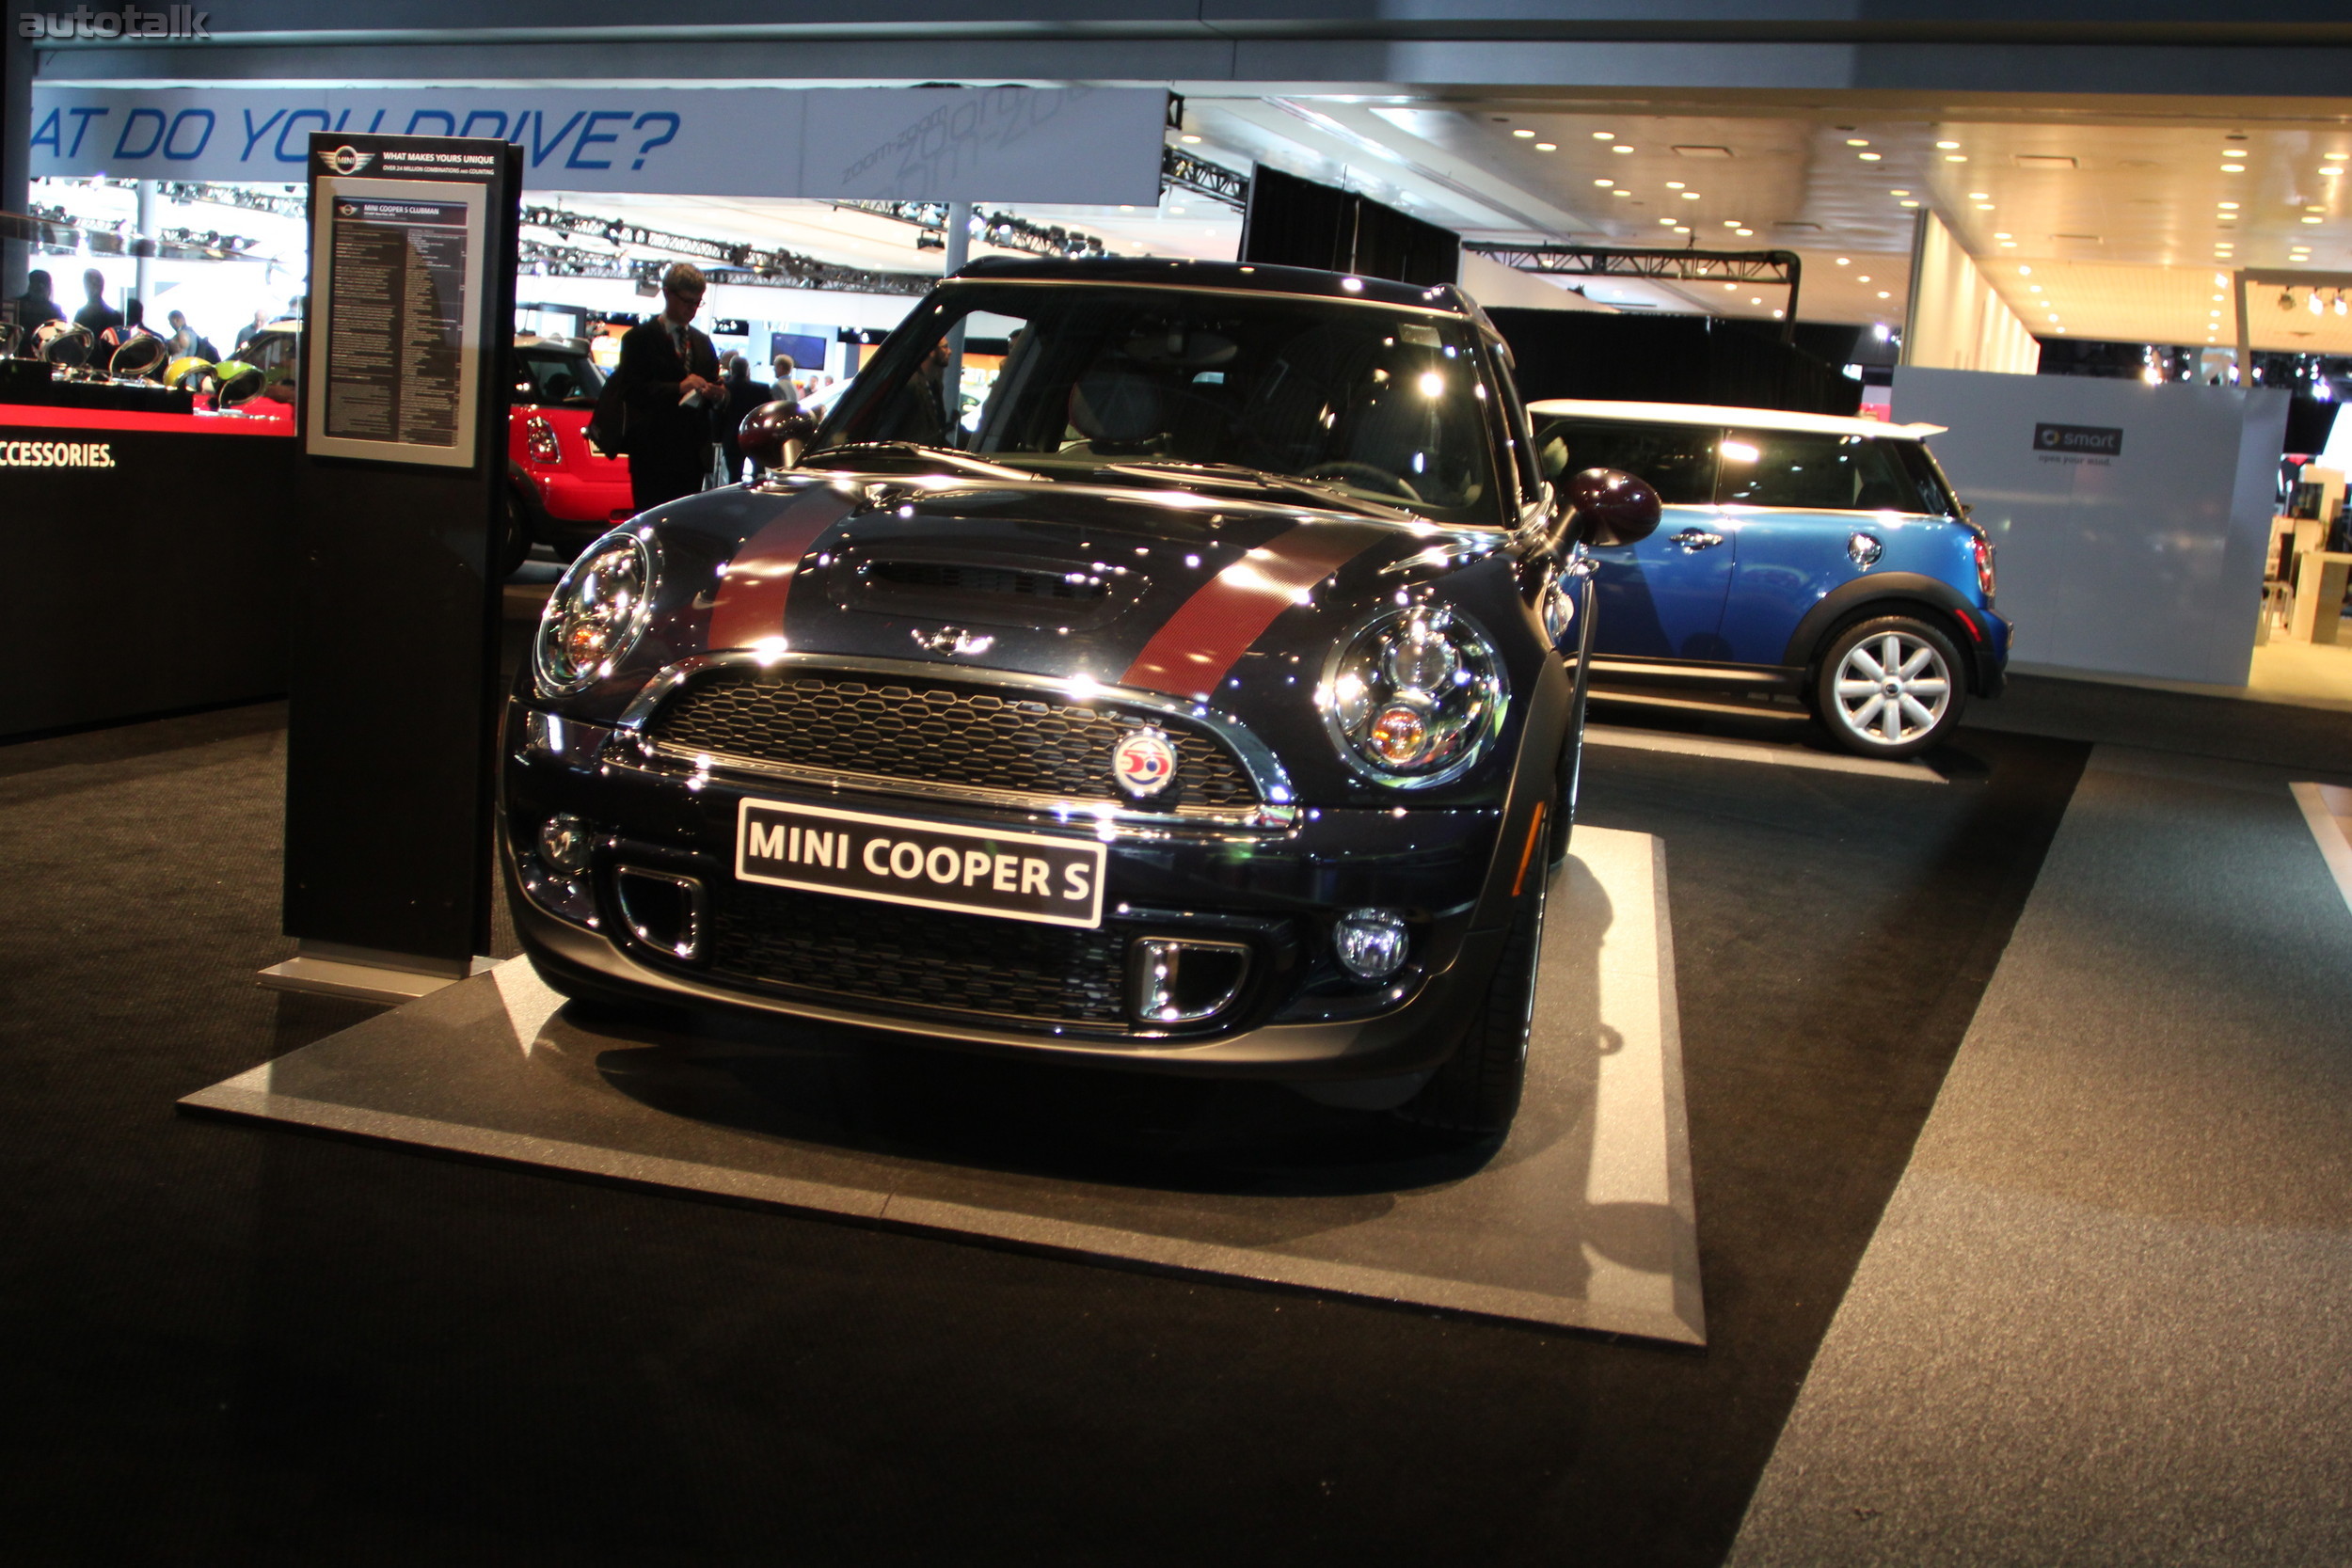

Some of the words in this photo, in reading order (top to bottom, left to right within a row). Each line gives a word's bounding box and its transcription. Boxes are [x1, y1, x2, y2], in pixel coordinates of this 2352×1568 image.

[112, 106, 215, 161] DO
[383, 151, 406, 161] WHAT
[407, 152, 435, 162] MAKES
[435, 153, 462, 164] YOURS
[463, 155, 495, 165] UNIQUE
[409, 207, 440, 215] CLUBMAN
[2063, 432, 2115, 448] smart
[2038, 454, 2061, 464] open
[2062, 455, 2085, 466] your
[2087, 456, 2112, 467] mind.
[748, 820, 849, 870] MINI
[862, 836, 1052, 897] COOPER
[1063, 862, 1090, 901] S
